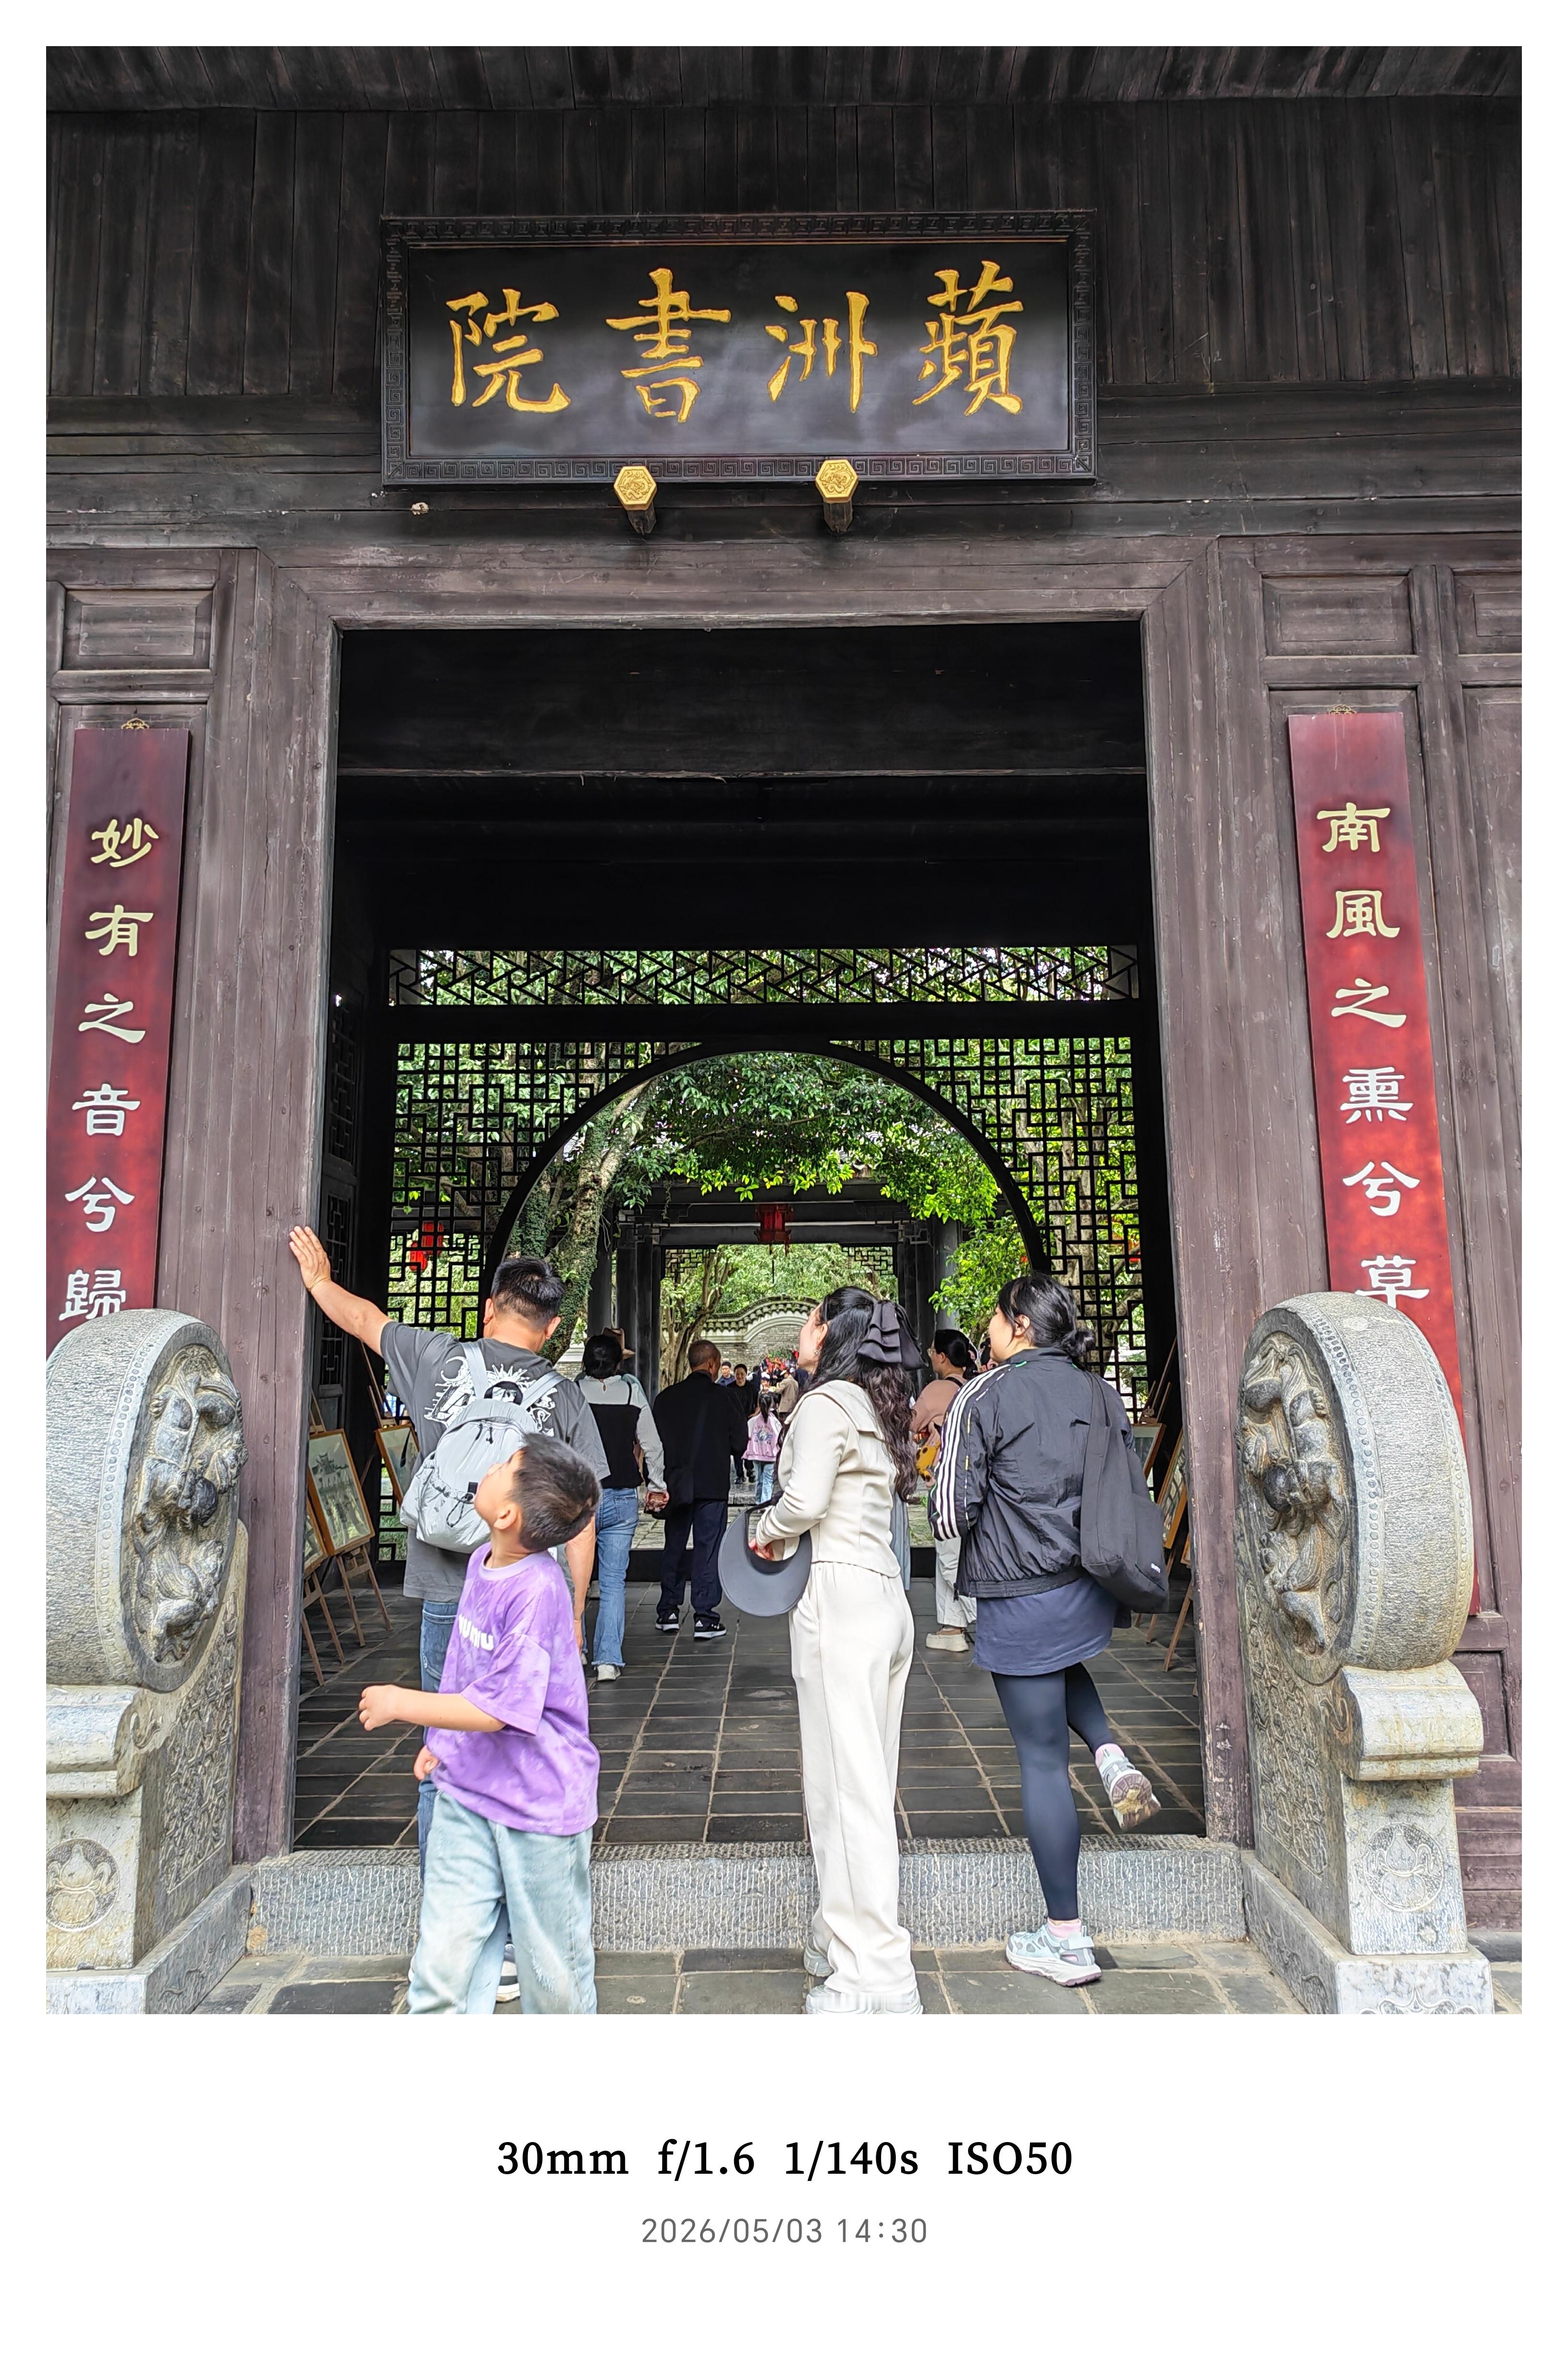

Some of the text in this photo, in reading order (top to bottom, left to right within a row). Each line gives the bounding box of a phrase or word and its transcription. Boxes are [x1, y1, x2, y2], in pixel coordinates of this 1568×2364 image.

[446, 260, 1024, 423] 蘋洲書院
[59, 818, 159, 1321] 妙有之音兮歸
[1316, 802, 1430, 1309] 南風之熏兮草
